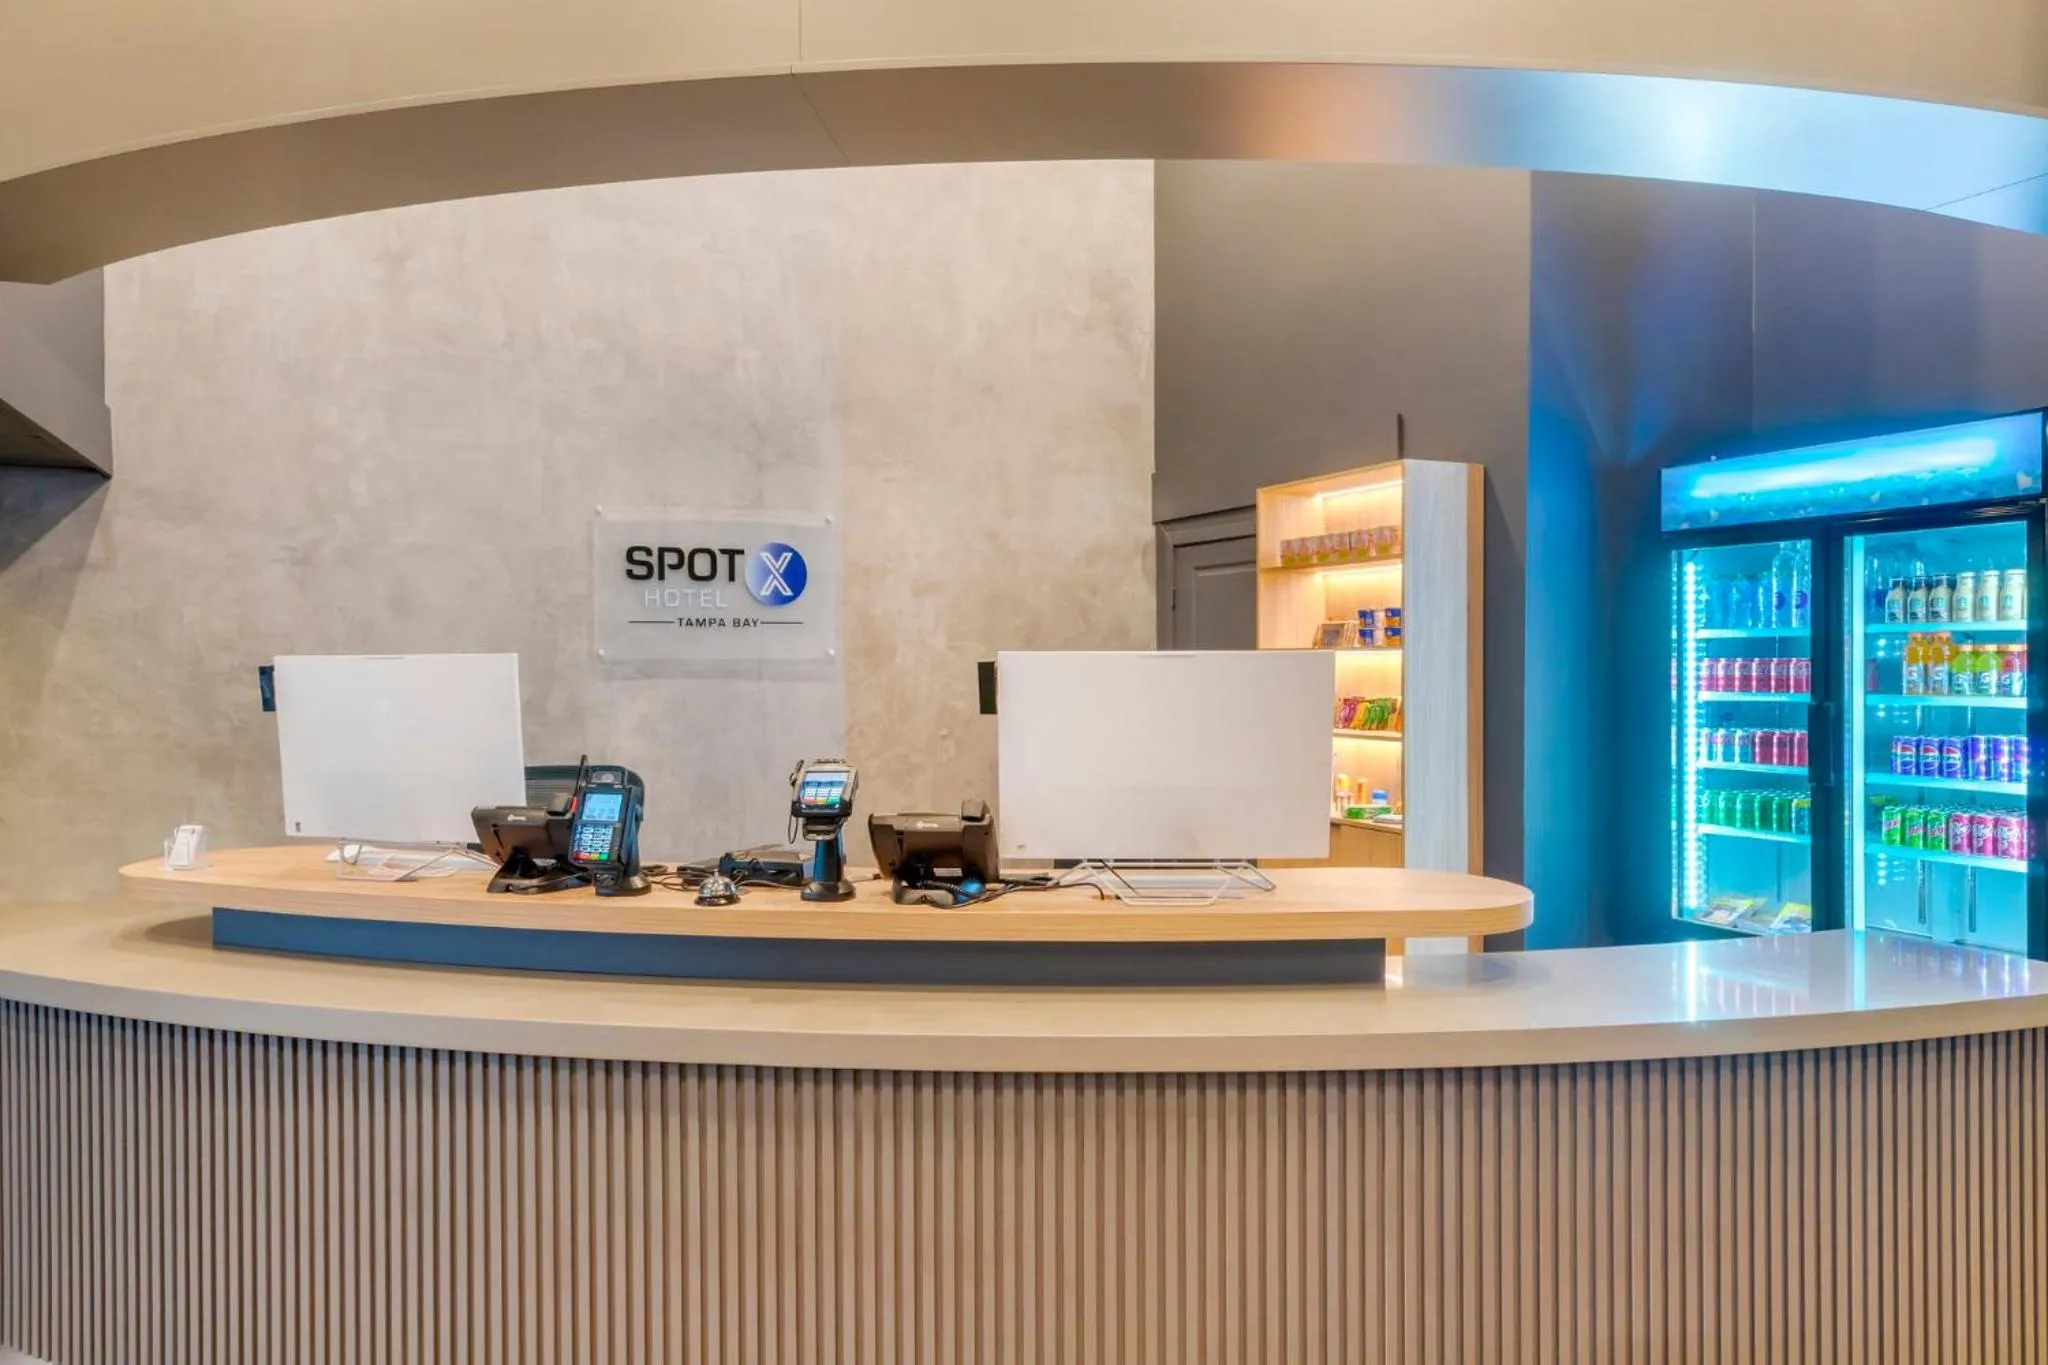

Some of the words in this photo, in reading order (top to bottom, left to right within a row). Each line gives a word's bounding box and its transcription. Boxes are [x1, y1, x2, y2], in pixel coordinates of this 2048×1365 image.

[626, 546, 745, 582] SPOT
[759, 552, 794, 596] X
[644, 588, 729, 608] HOTEL
[676, 617, 727, 628] TAMPA
[732, 617, 760, 628] BAY
